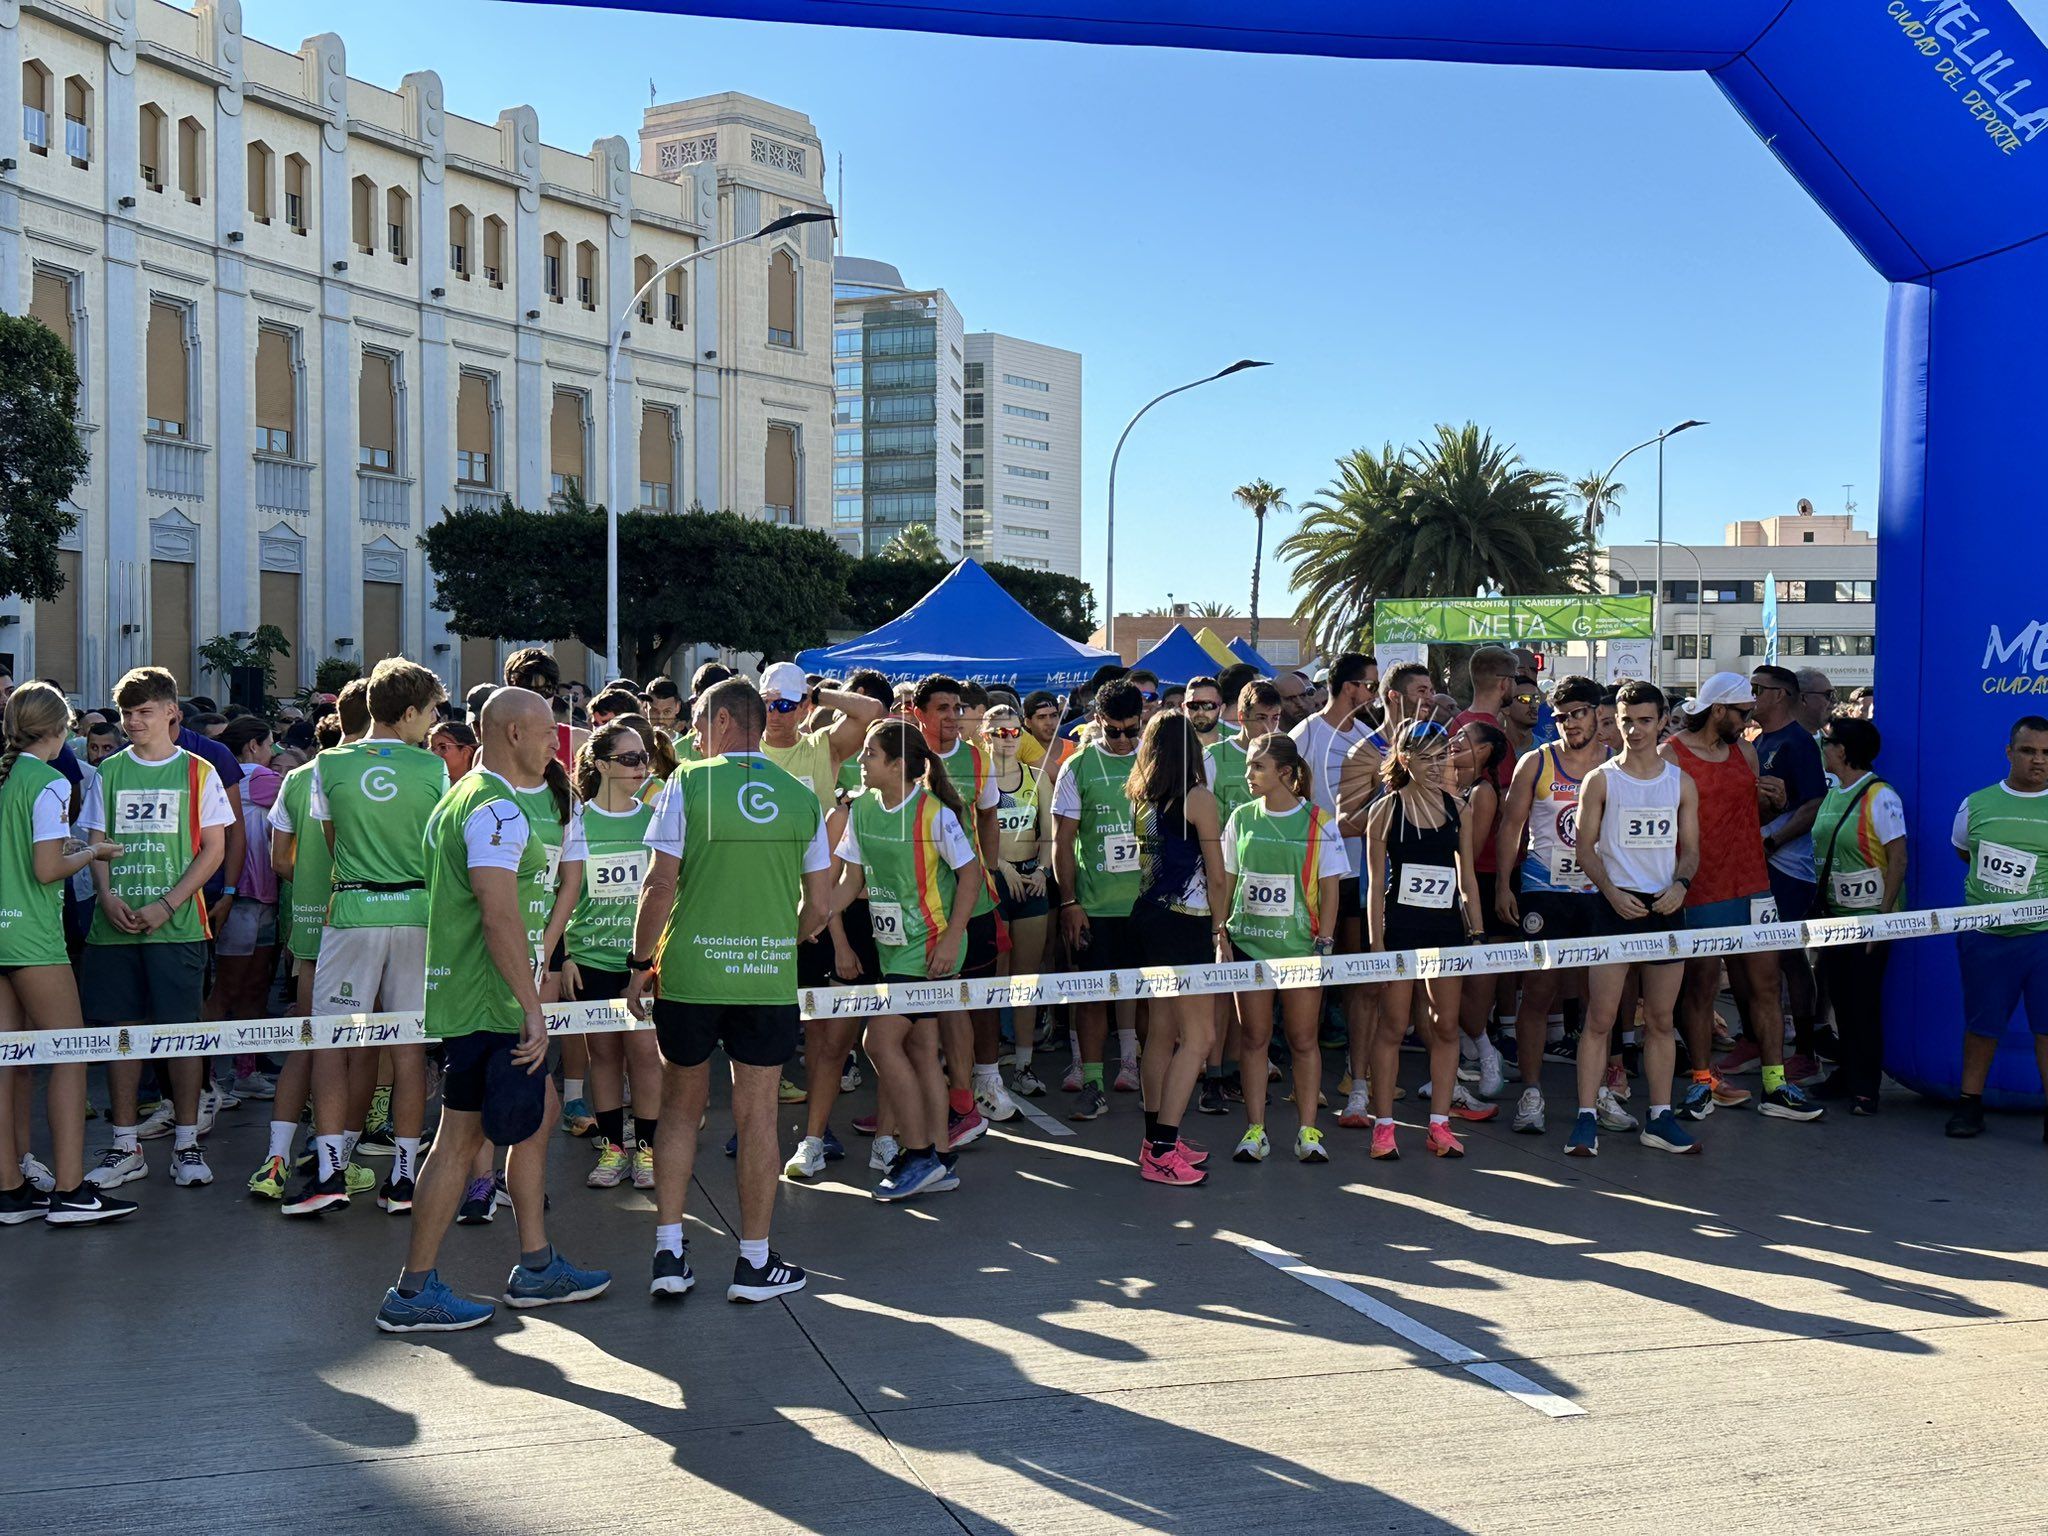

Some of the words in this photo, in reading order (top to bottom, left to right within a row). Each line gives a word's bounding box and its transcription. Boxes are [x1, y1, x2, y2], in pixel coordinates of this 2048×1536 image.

[1888, 0, 1940, 56] CIUDAD
[1935, 57, 1966, 92] DEL
[1962, 89, 2022, 155] DEPORTE
[1473, 600, 1510, 608] CONTRA
[1468, 614, 1547, 638] META
[965, 672, 1018, 685] MELILLA
[1046, 671, 1099, 685] MELILL
[125, 803, 168, 820] 321
[1095, 803, 1110, 815] En
[998, 814, 1029, 829] 305
[1628, 819, 1671, 836] 319
[122, 839, 166, 853] archa
[1113, 844, 1138, 861] 37
[111, 863, 156, 876] contra
[1983, 855, 2027, 878] 1053
[596, 864, 639, 885] 301
[109, 884, 124, 897] el
[127, 883, 171, 896] cánce
[1408, 876, 1450, 896] 327
[1839, 879, 1878, 897] 870
[380, 892, 411, 903] Melilla
[1247, 885, 1287, 904] 308
[585, 915, 631, 927] contra
[1759, 907, 1778, 924] 62
[1884, 916, 1926, 929] MELILLA
[1953, 912, 2001, 931] MELILLA
[872, 915, 896, 932] 09
[1243, 923, 1289, 940] cáncer
[1754, 927, 1796, 940] MELILLA
[1823, 925, 1874, 943] MELILLA
[582, 934, 596, 947] el
[598, 933, 634, 947] cánc
[693, 934, 758, 946] Asociación
[1620, 938, 1663, 951] MELILLA
[1692, 936, 1743, 954] MELILLA
[704, 948, 744, 960] Contra
[747, 950, 758, 960] el
[1484, 948, 1528, 960] MELILLA
[1557, 946, 1609, 965] MELILLA
[725, 965, 740, 974] en
[743, 963, 779, 974] Melilla
[1345, 958, 1390, 971] MELILLA
[1203, 968, 1249, 981] MELILLA
[1056, 977, 1104, 990] MELILLA
[905, 987, 953, 1000] MELILLA
[832, 995, 892, 1014] MELILLA
[237, 1025, 294, 1039] MELILLA
[332, 1023, 400, 1044] MELILLA
[52, 1035, 110, 1048] MELILLA
[151, 1033, 221, 1054] MELILLA
